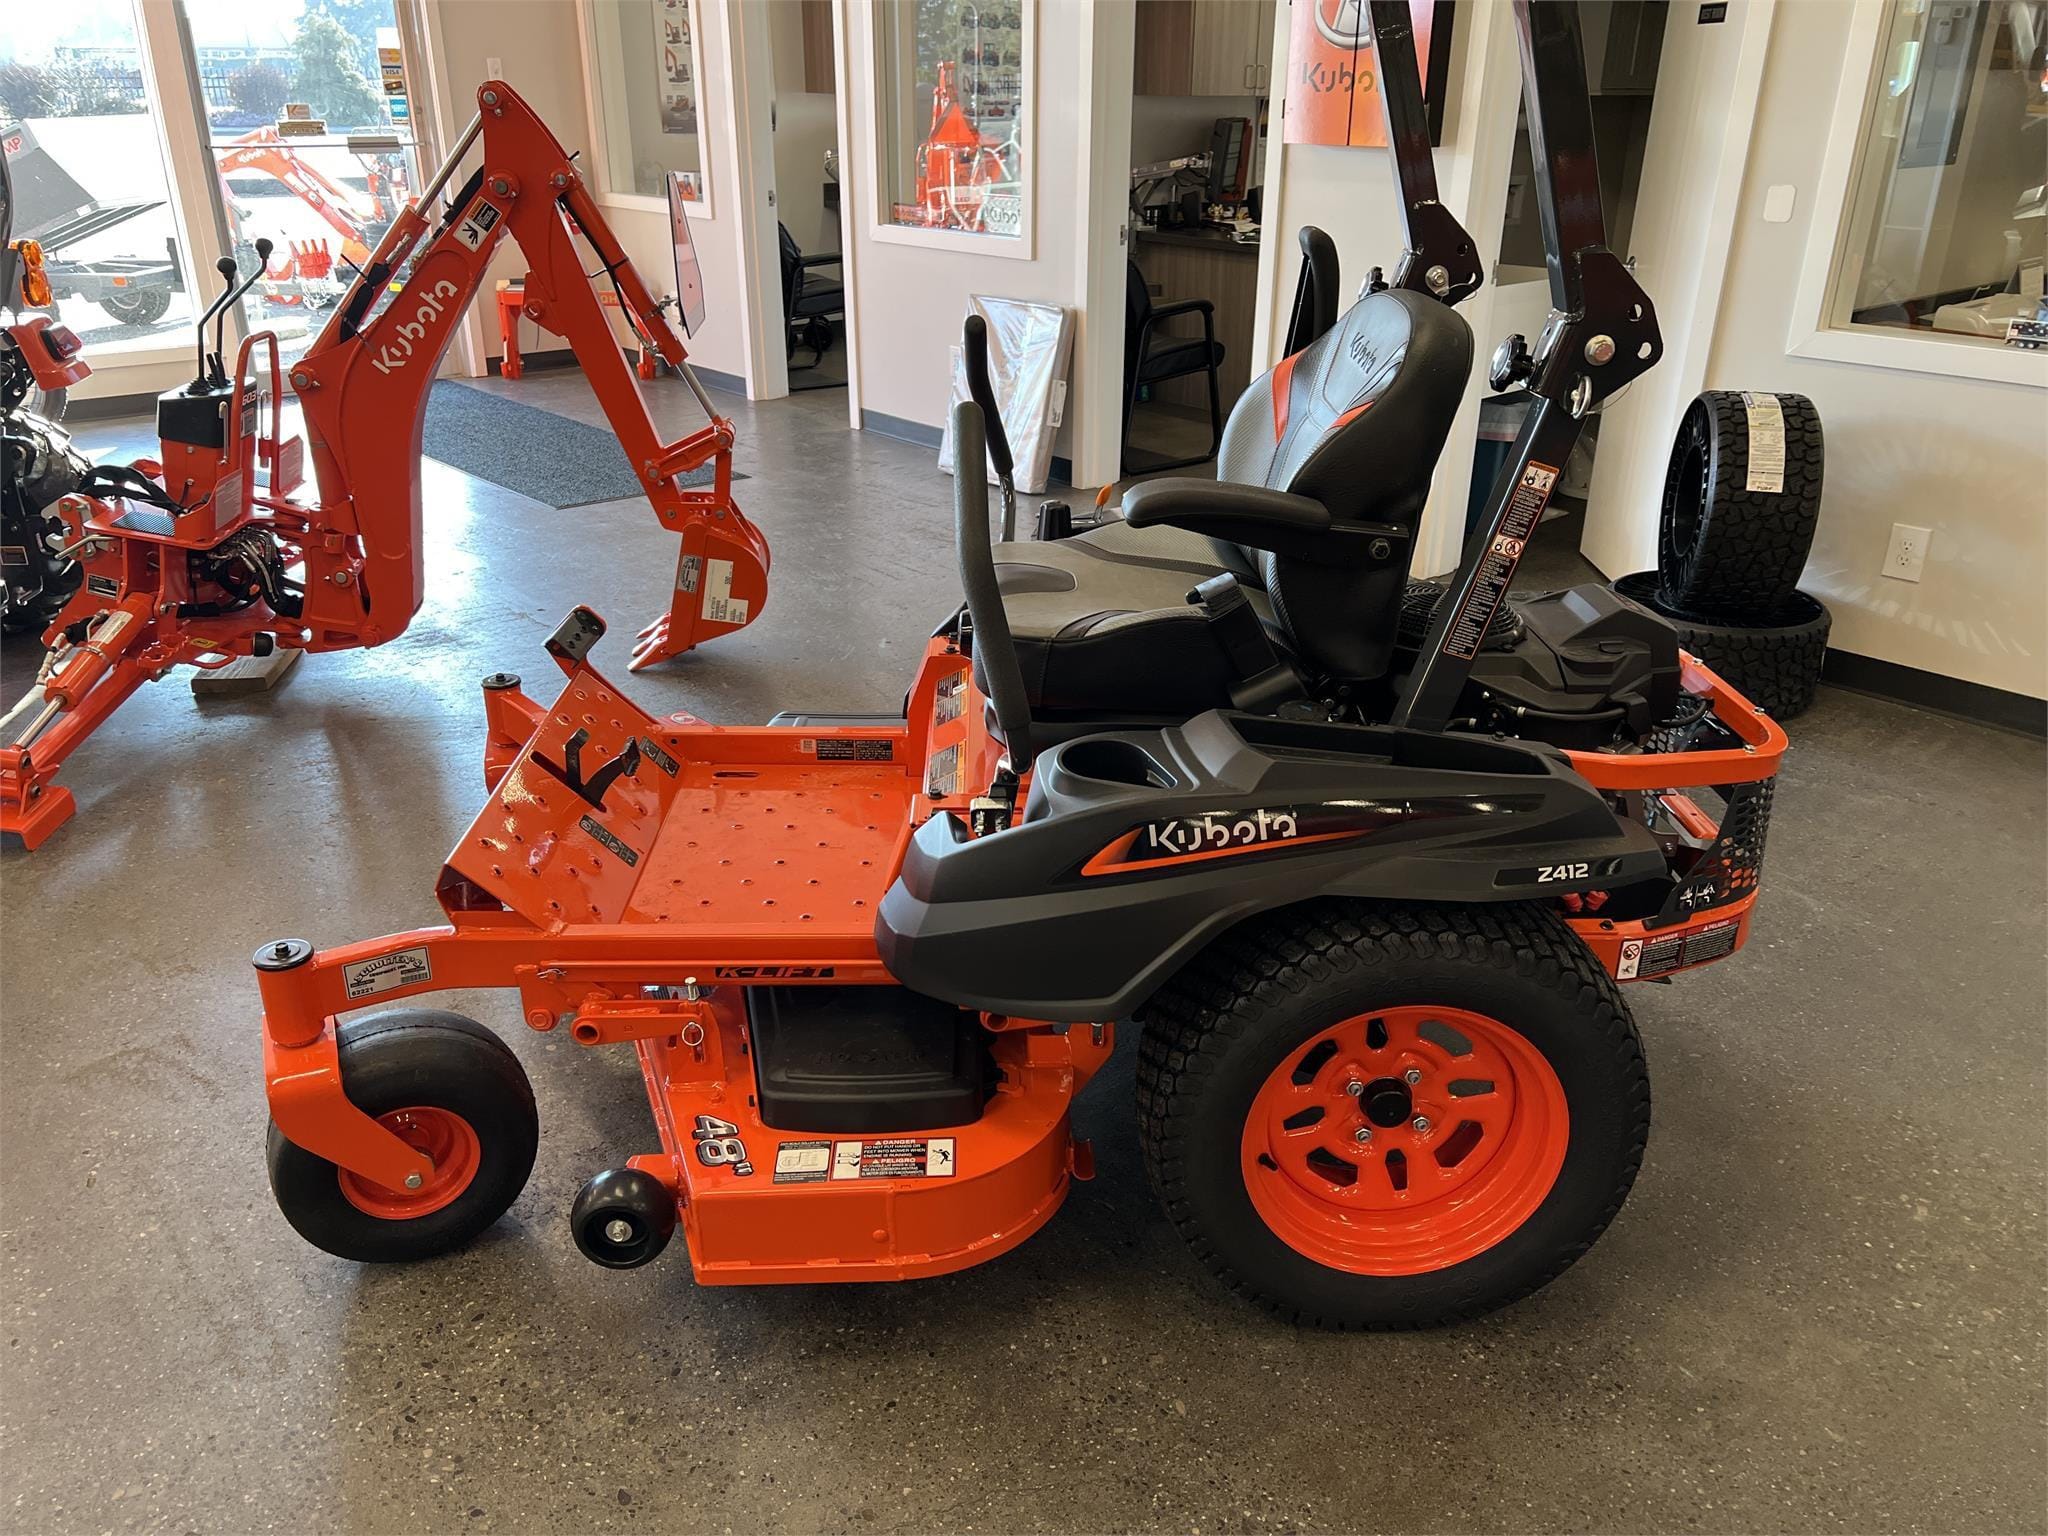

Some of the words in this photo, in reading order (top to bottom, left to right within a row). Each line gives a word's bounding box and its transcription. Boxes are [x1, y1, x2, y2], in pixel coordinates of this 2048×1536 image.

[1302, 62, 1379, 92] Kubo
[372, 280, 459, 375] Kubota
[1350, 332, 1378, 375] Kubota
[1149, 809, 1296, 853] Kubota
[1538, 862, 1589, 883] Z412
[718, 966, 828, 978] K-LIFT
